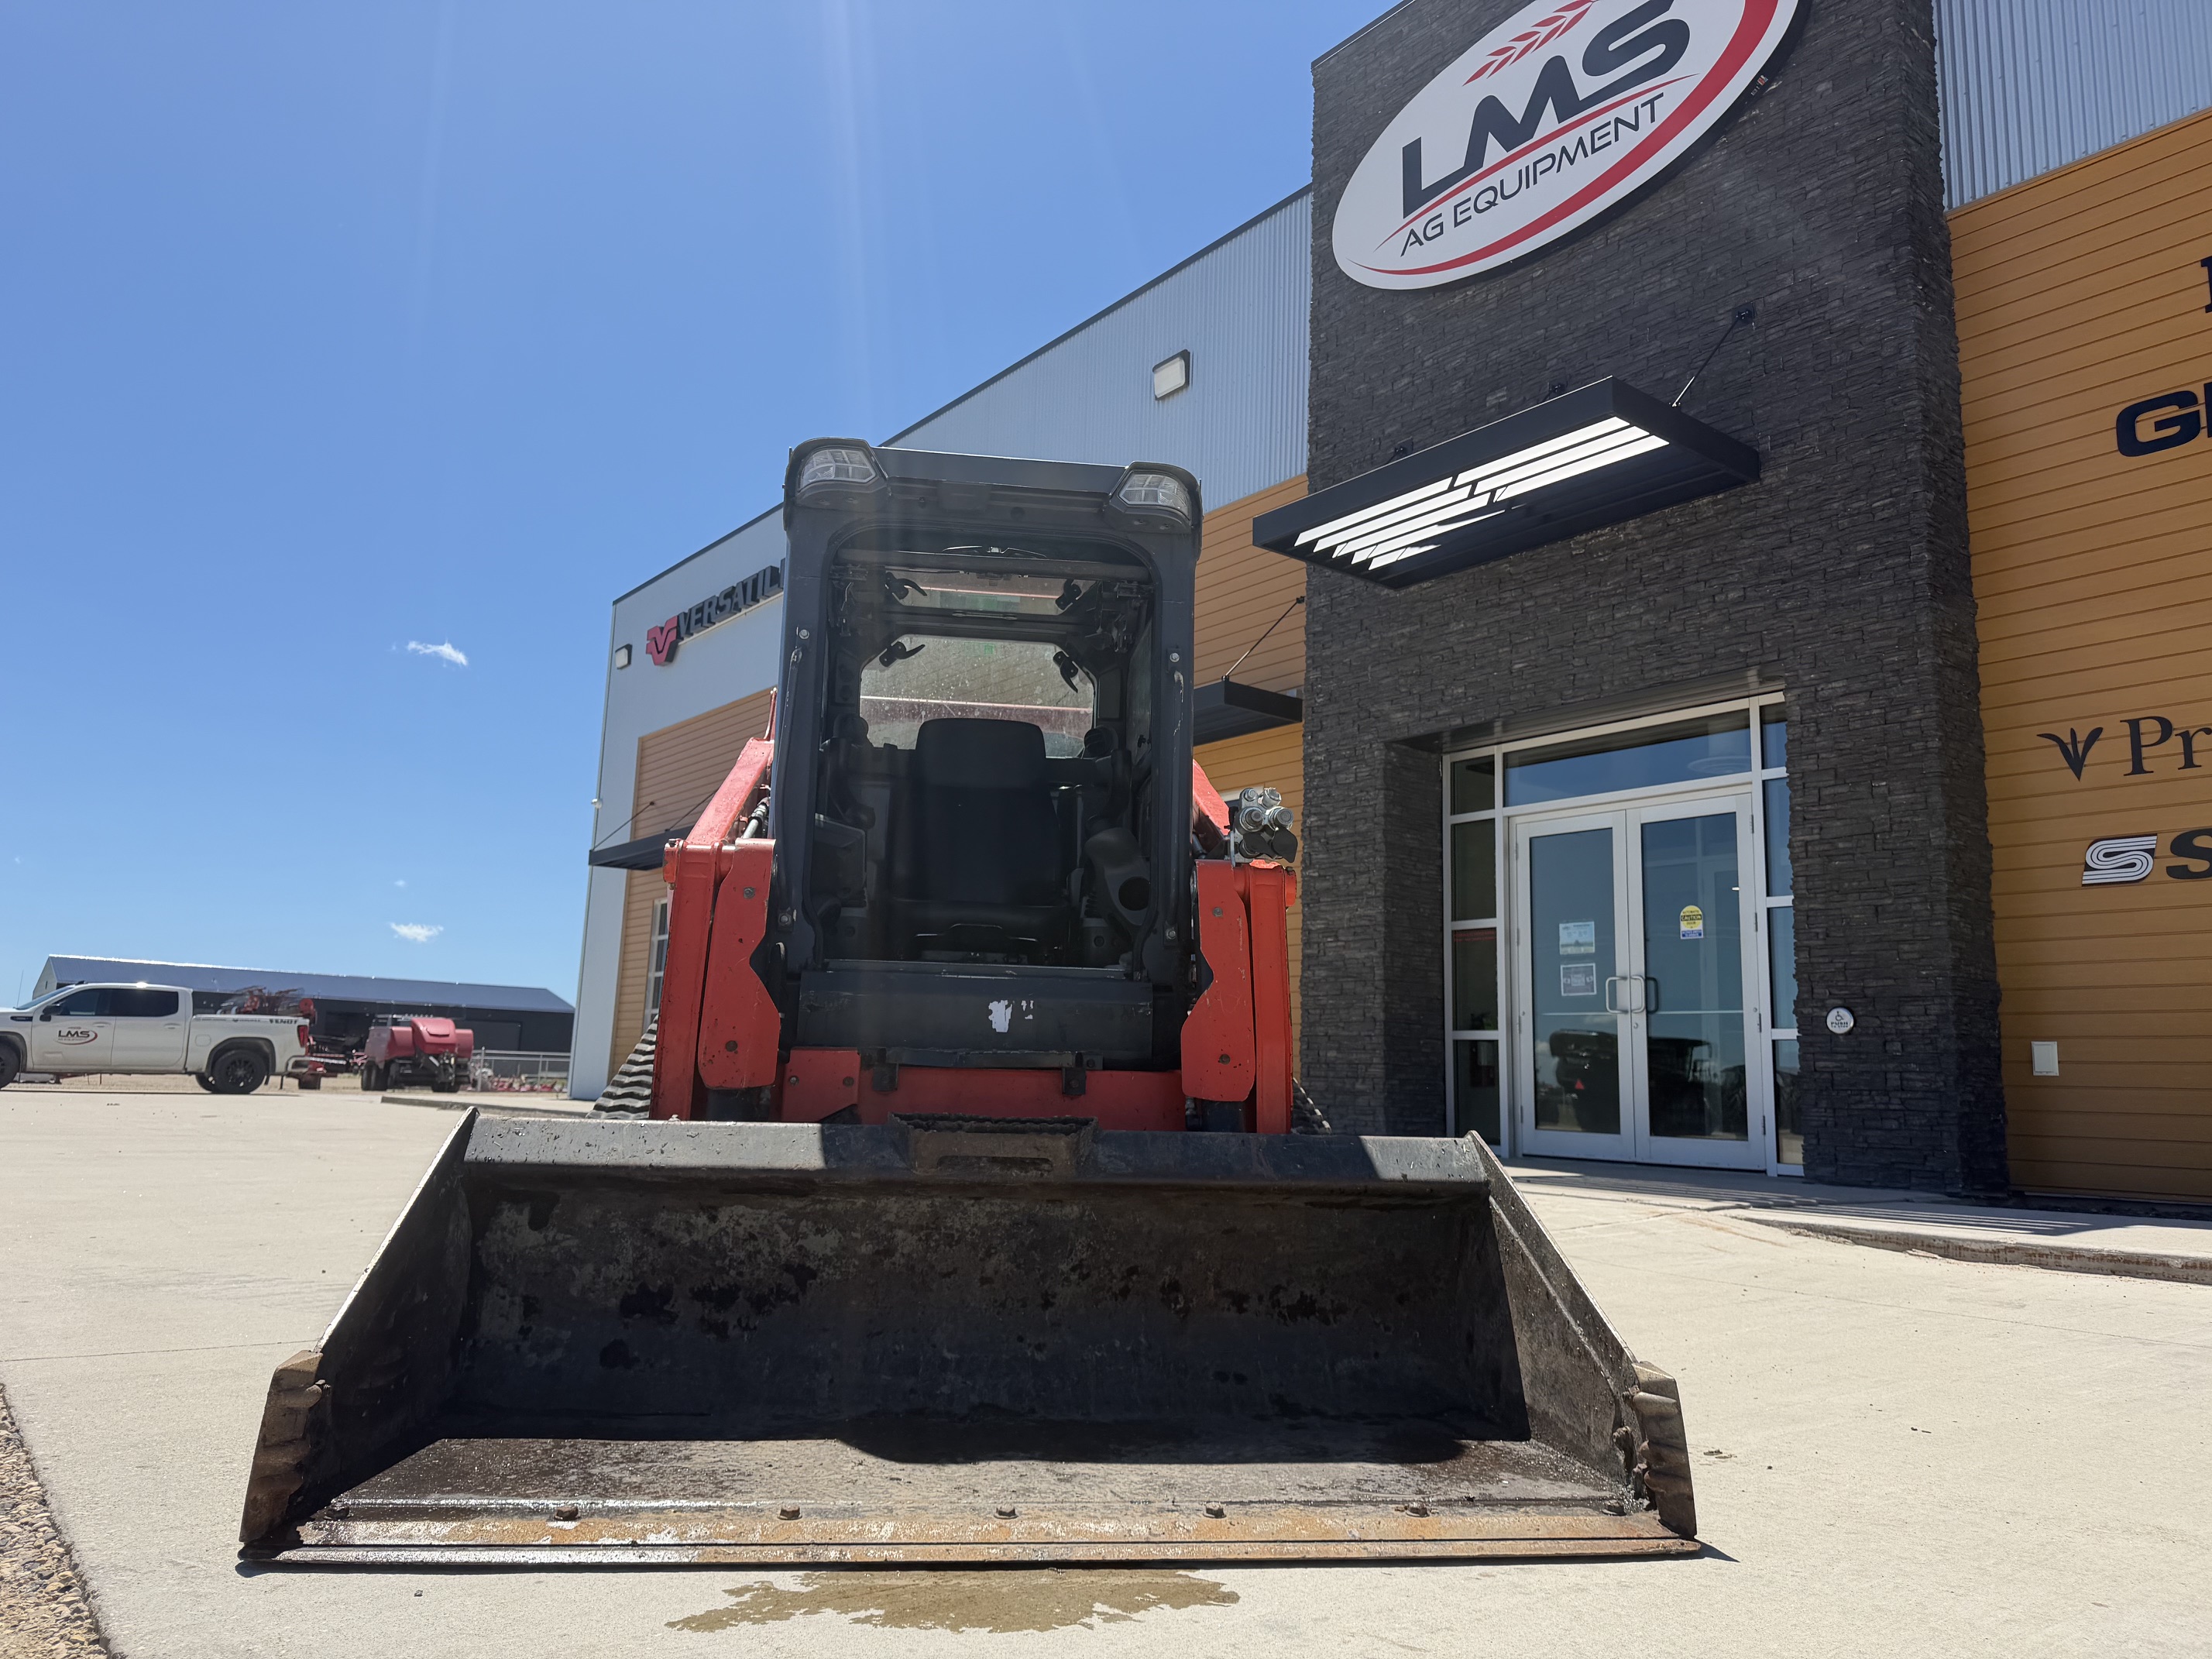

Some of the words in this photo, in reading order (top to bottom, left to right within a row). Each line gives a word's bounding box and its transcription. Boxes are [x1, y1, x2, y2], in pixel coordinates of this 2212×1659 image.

[1400, 213, 1445, 258] AG
[1453, 92, 1665, 228] EQUIPMENT
[1402, 0, 1691, 219] LMS
[2116, 382, 2212, 457] G
